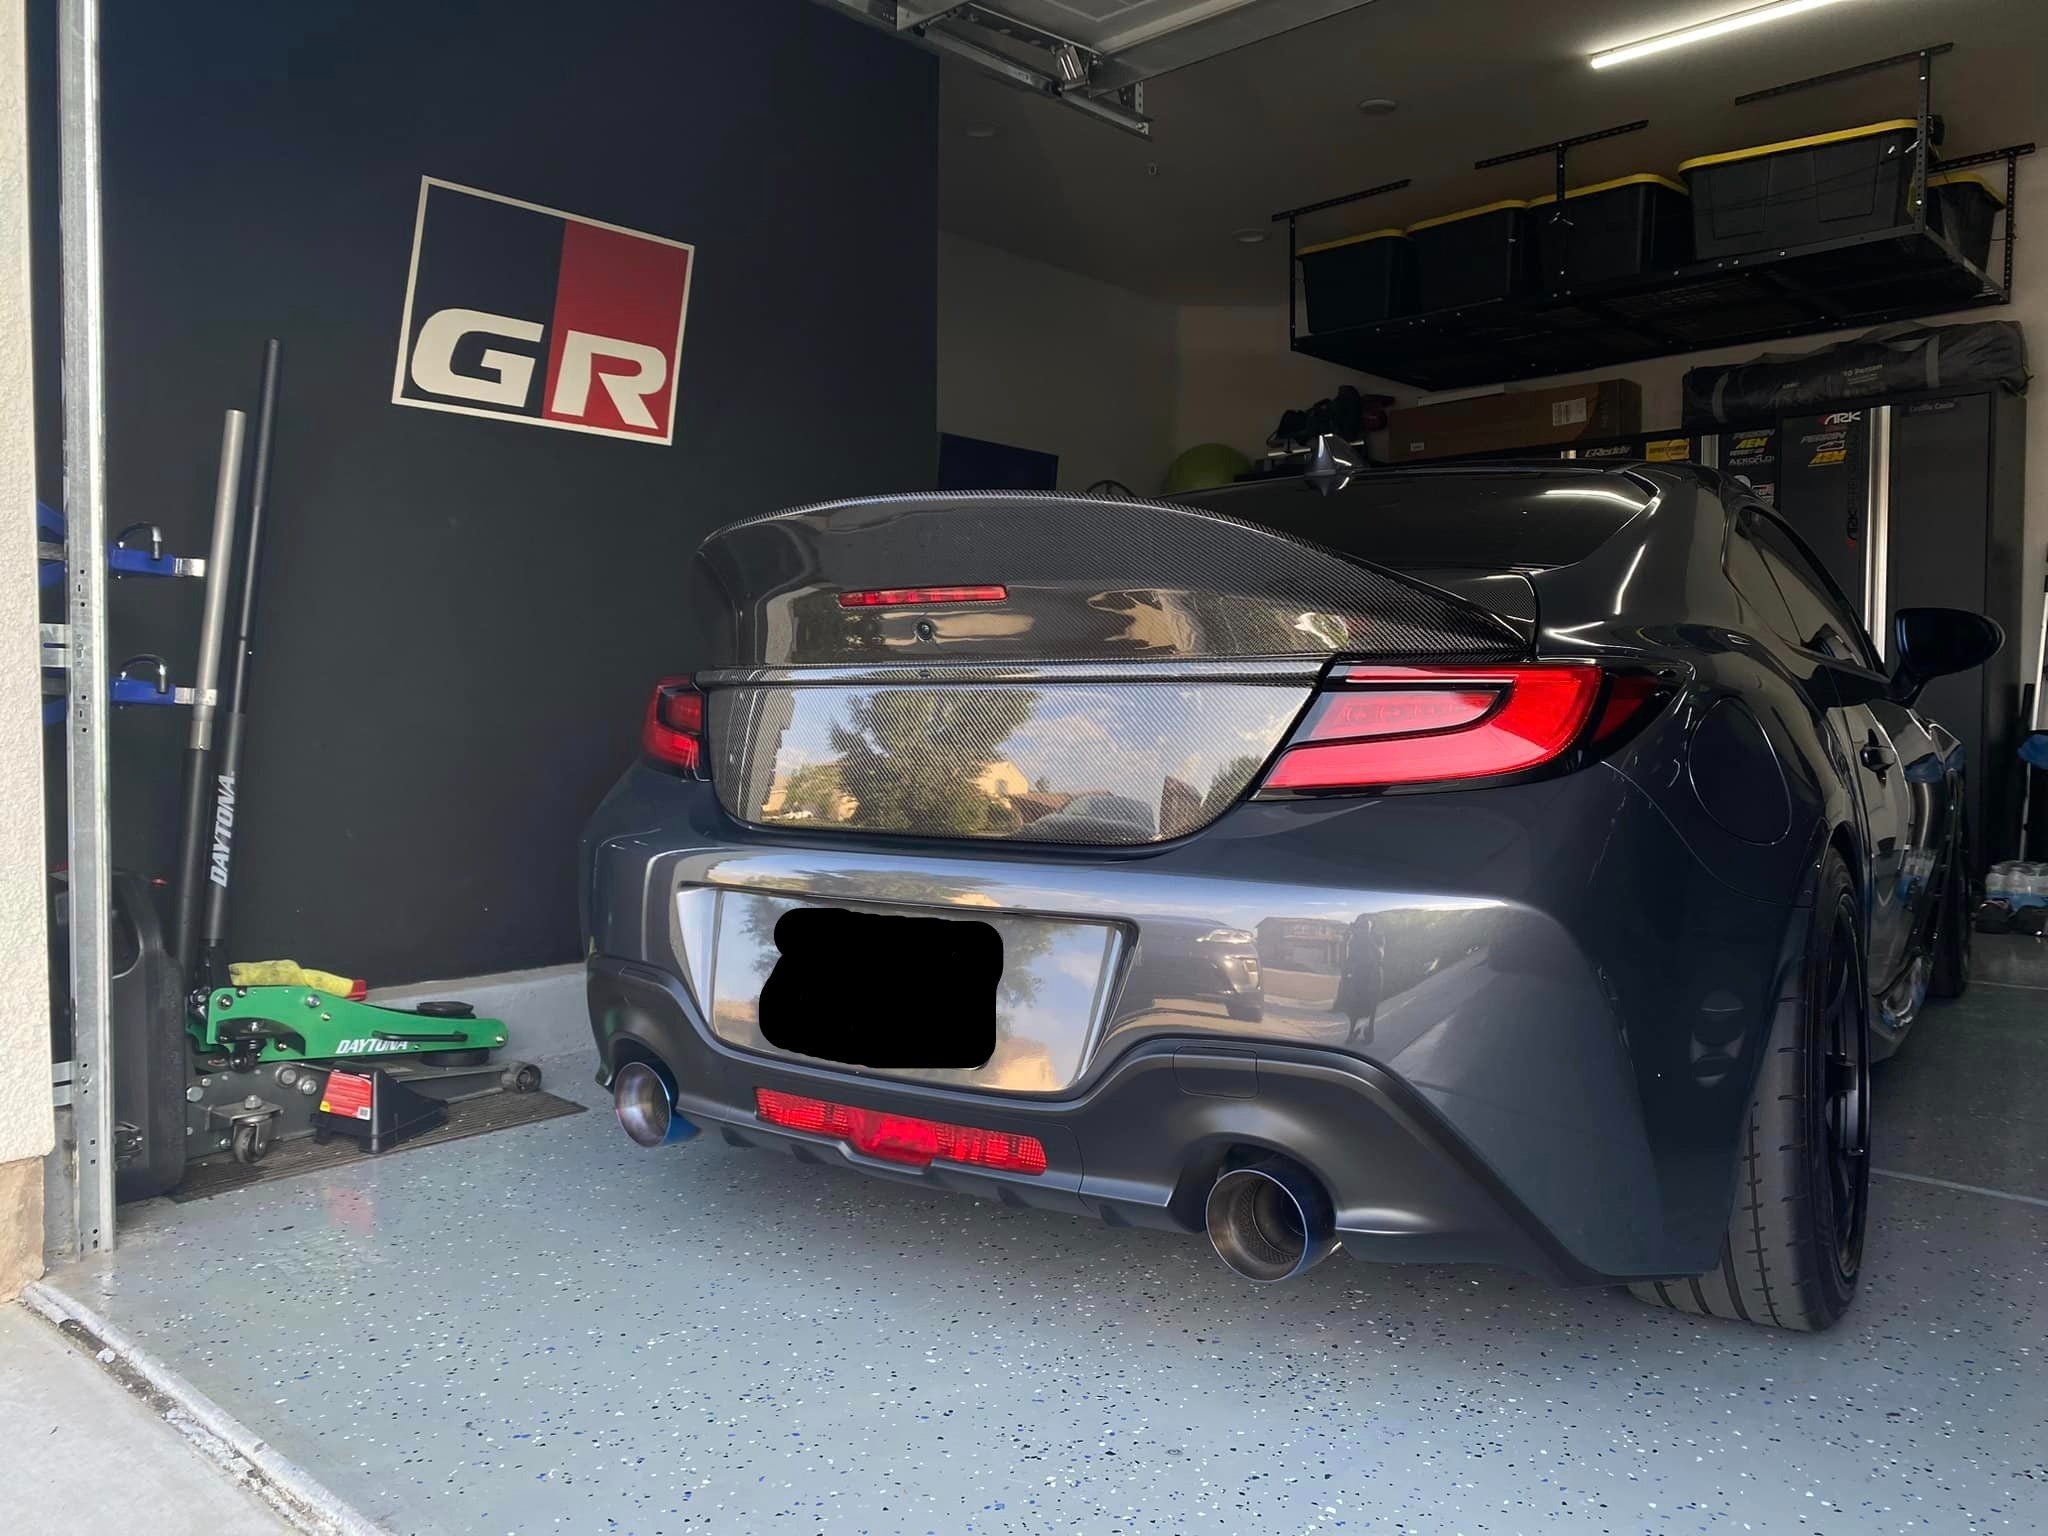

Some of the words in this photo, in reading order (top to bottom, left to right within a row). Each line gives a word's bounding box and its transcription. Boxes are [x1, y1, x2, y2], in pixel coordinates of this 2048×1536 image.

[411, 307, 667, 429] GR
[1824, 411, 1861, 425] ARK
[210, 772, 236, 888] DAYTONA
[335, 1038, 408, 1054] DAYTONA
